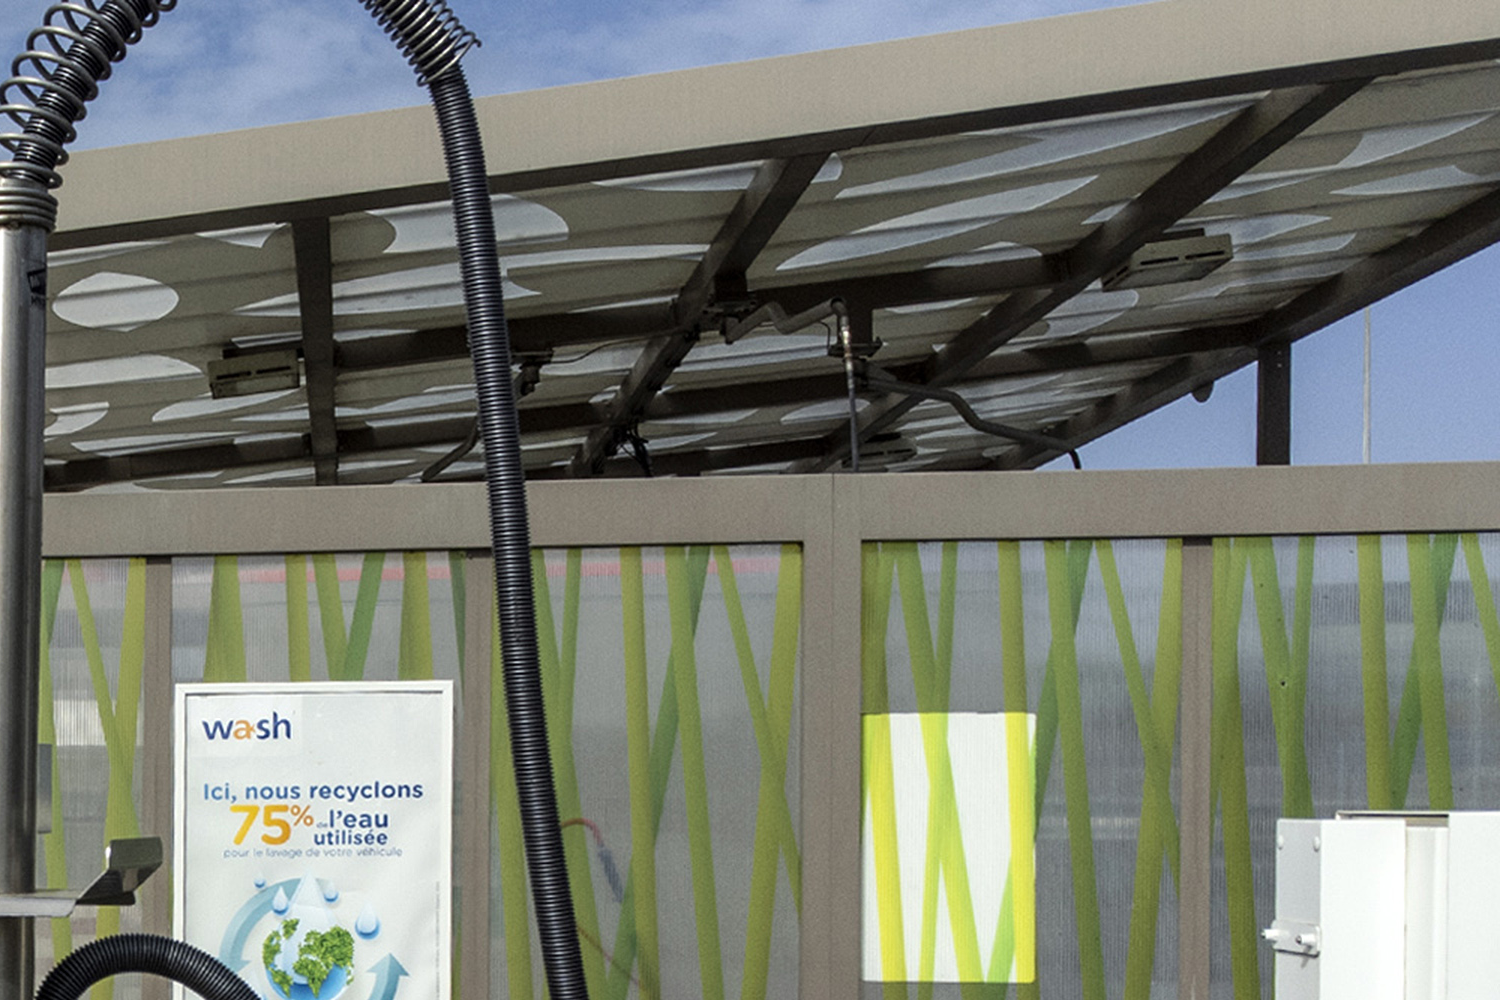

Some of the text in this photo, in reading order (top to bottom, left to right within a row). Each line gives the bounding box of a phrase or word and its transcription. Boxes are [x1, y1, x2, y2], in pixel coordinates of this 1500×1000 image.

[202, 712, 291, 740] wash
[204, 781, 424, 803] Ici, nous recyclons
[229, 804, 314, 846] 75%
[314, 829, 388, 845] utilisée
[223, 847, 403, 859] pour le lavage de votre véhicule
